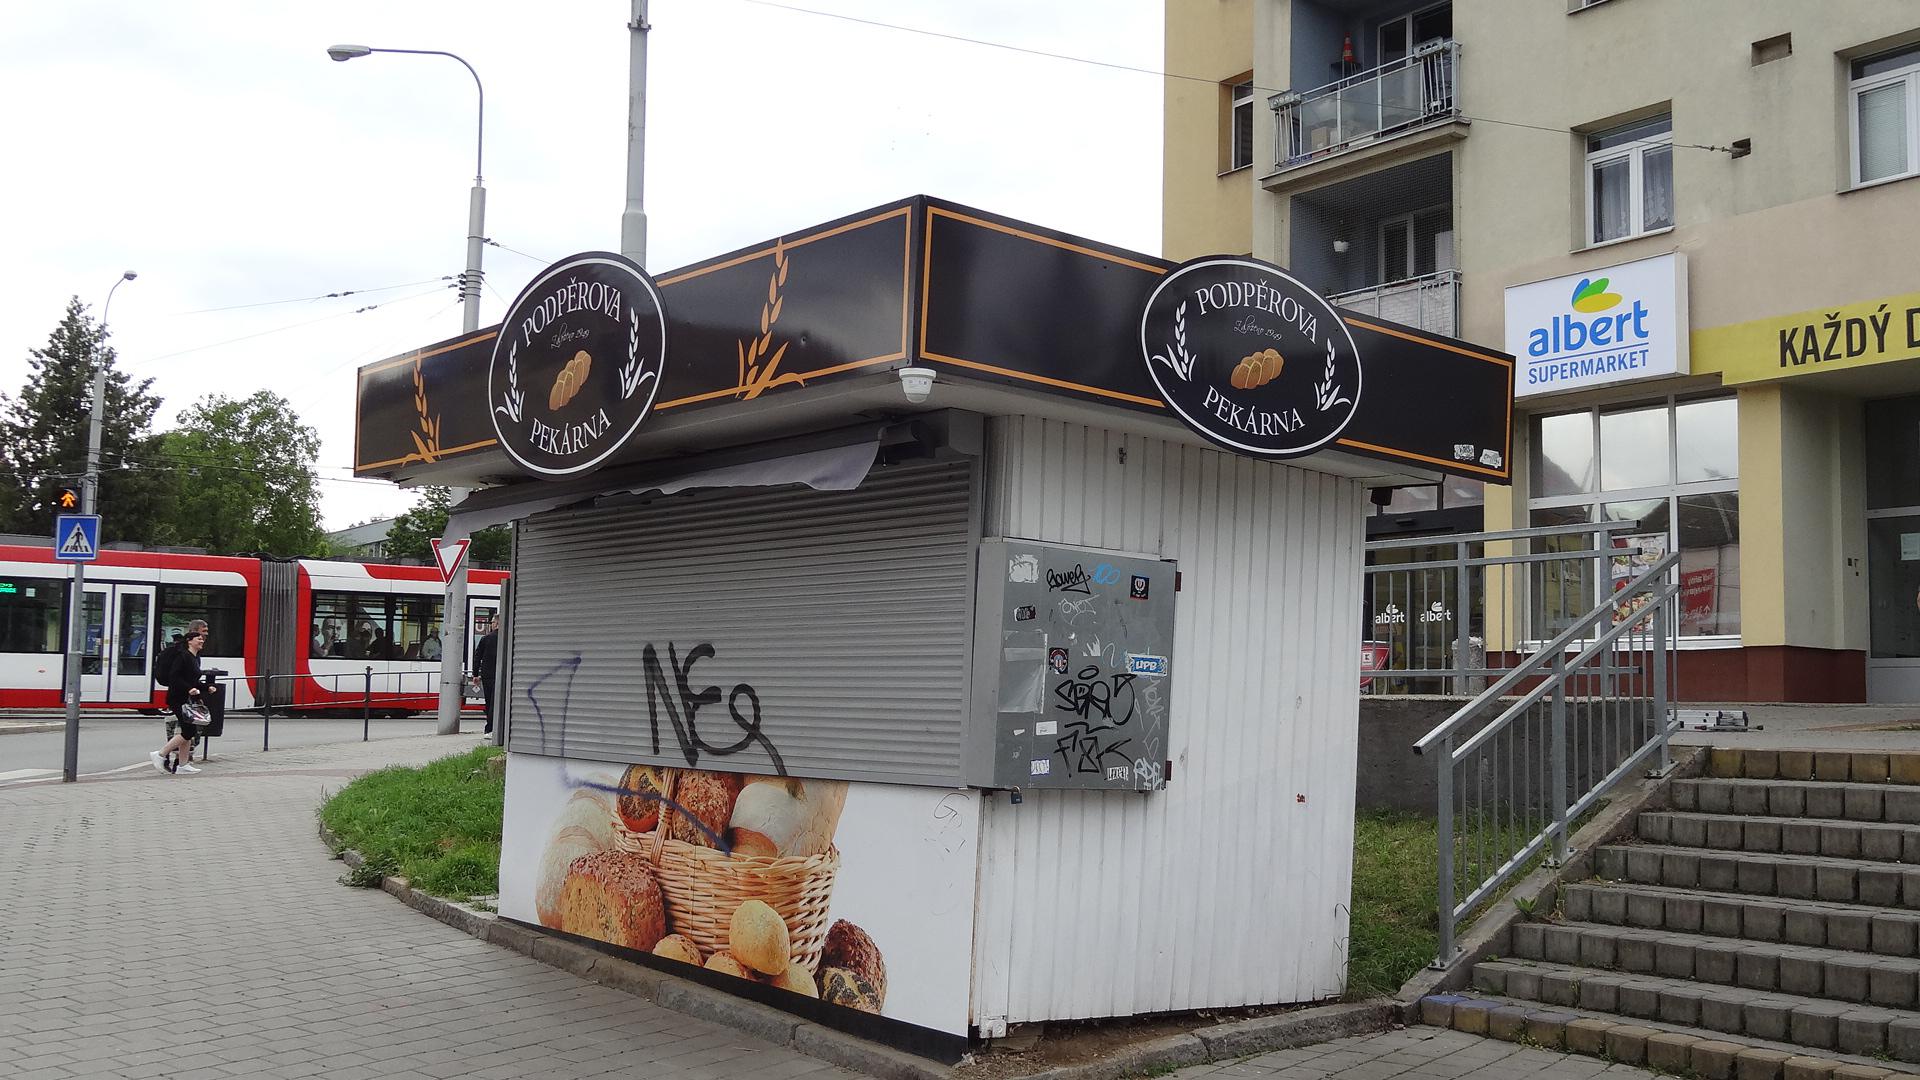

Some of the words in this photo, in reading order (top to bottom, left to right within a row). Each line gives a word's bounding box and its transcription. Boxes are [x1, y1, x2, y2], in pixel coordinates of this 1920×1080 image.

[521, 276, 621, 347] PODPĚROVA
[1195, 278, 1318, 345] PODPĚROVA
[1528, 300, 1650, 358] albert
[1779, 303, 1892, 368] KAŽDÝ
[1528, 348, 1650, 385] SUPERMARKET
[529, 407, 612, 455] PEKÁRNA
[1202, 384, 1306, 436] PEKÁRNA
